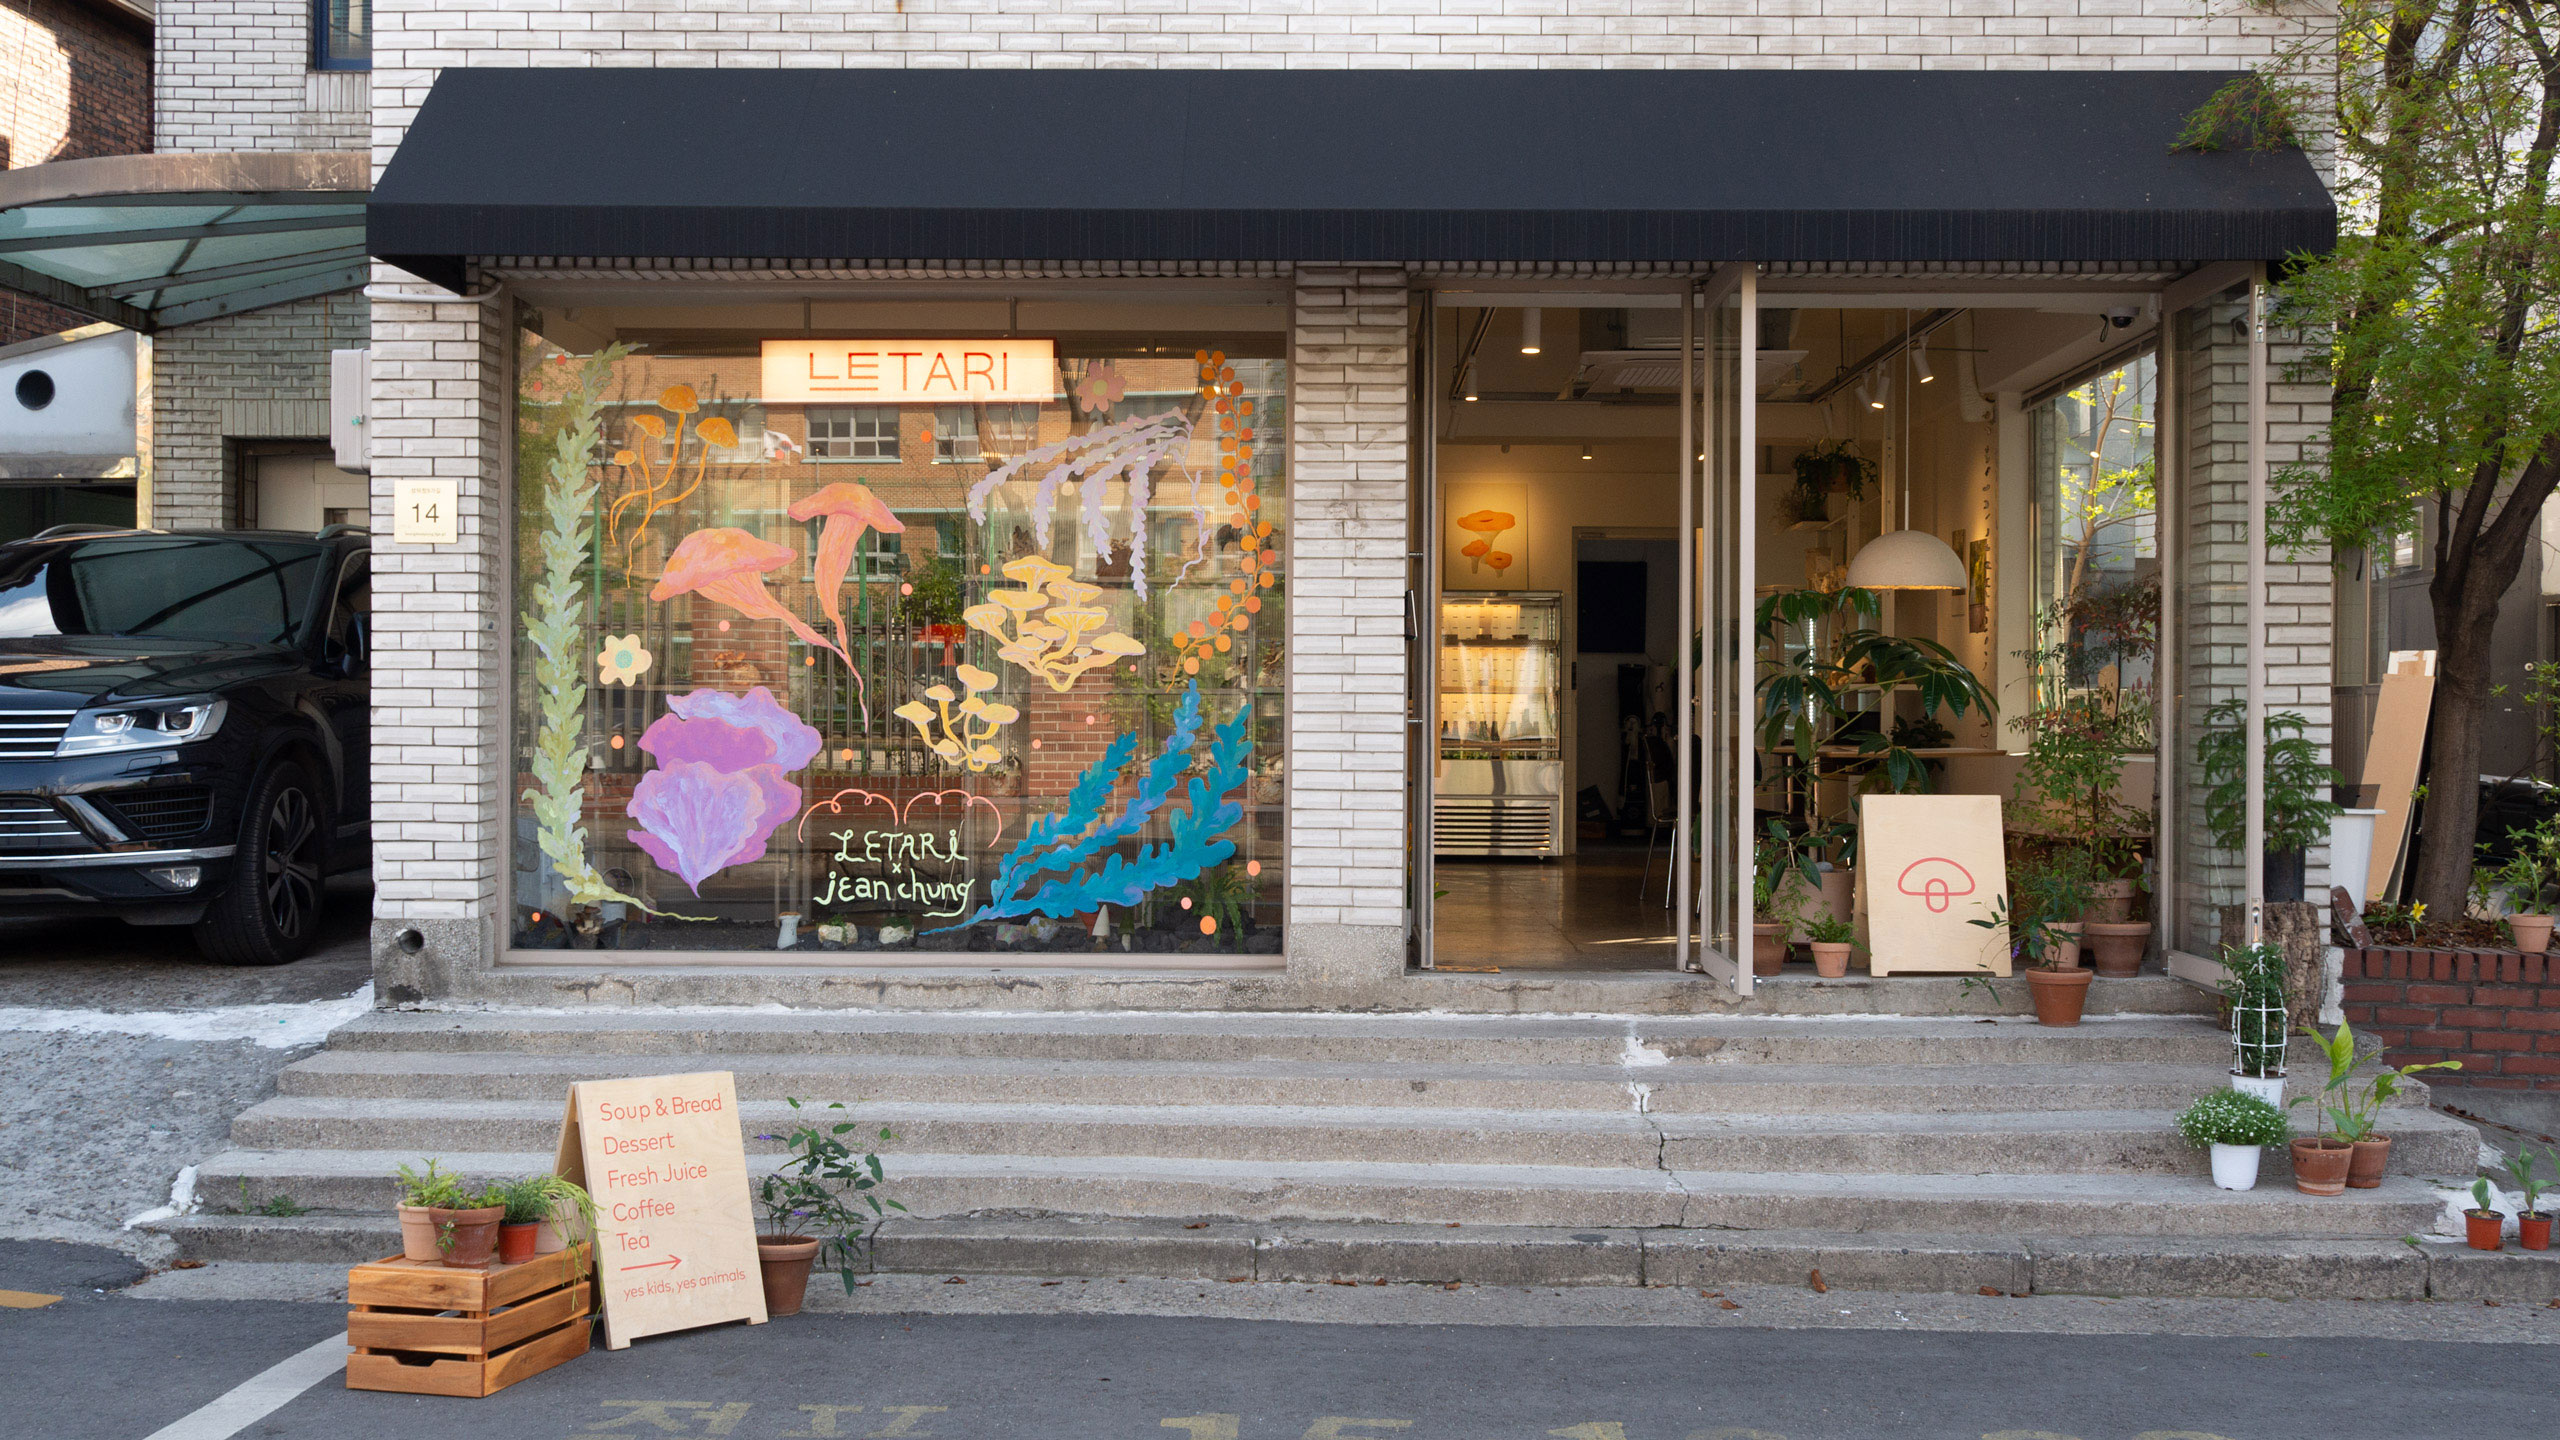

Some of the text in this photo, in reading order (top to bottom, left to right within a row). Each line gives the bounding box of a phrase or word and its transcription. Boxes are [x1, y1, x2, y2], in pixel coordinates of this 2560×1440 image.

[809, 352, 1007, 390] LETARI
[411, 503, 439, 523] 14
[813, 867, 976, 918] jean chung
[600, 1094, 721, 1121] Soup & Bread
[604, 1134, 674, 1154] Dessert
[608, 1163, 708, 1187] Fresh Juice
[613, 1199, 674, 1221] Coffee
[616, 1232, 649, 1250] Tea
[625, 1268, 745, 1301] yes kids, yes animals
